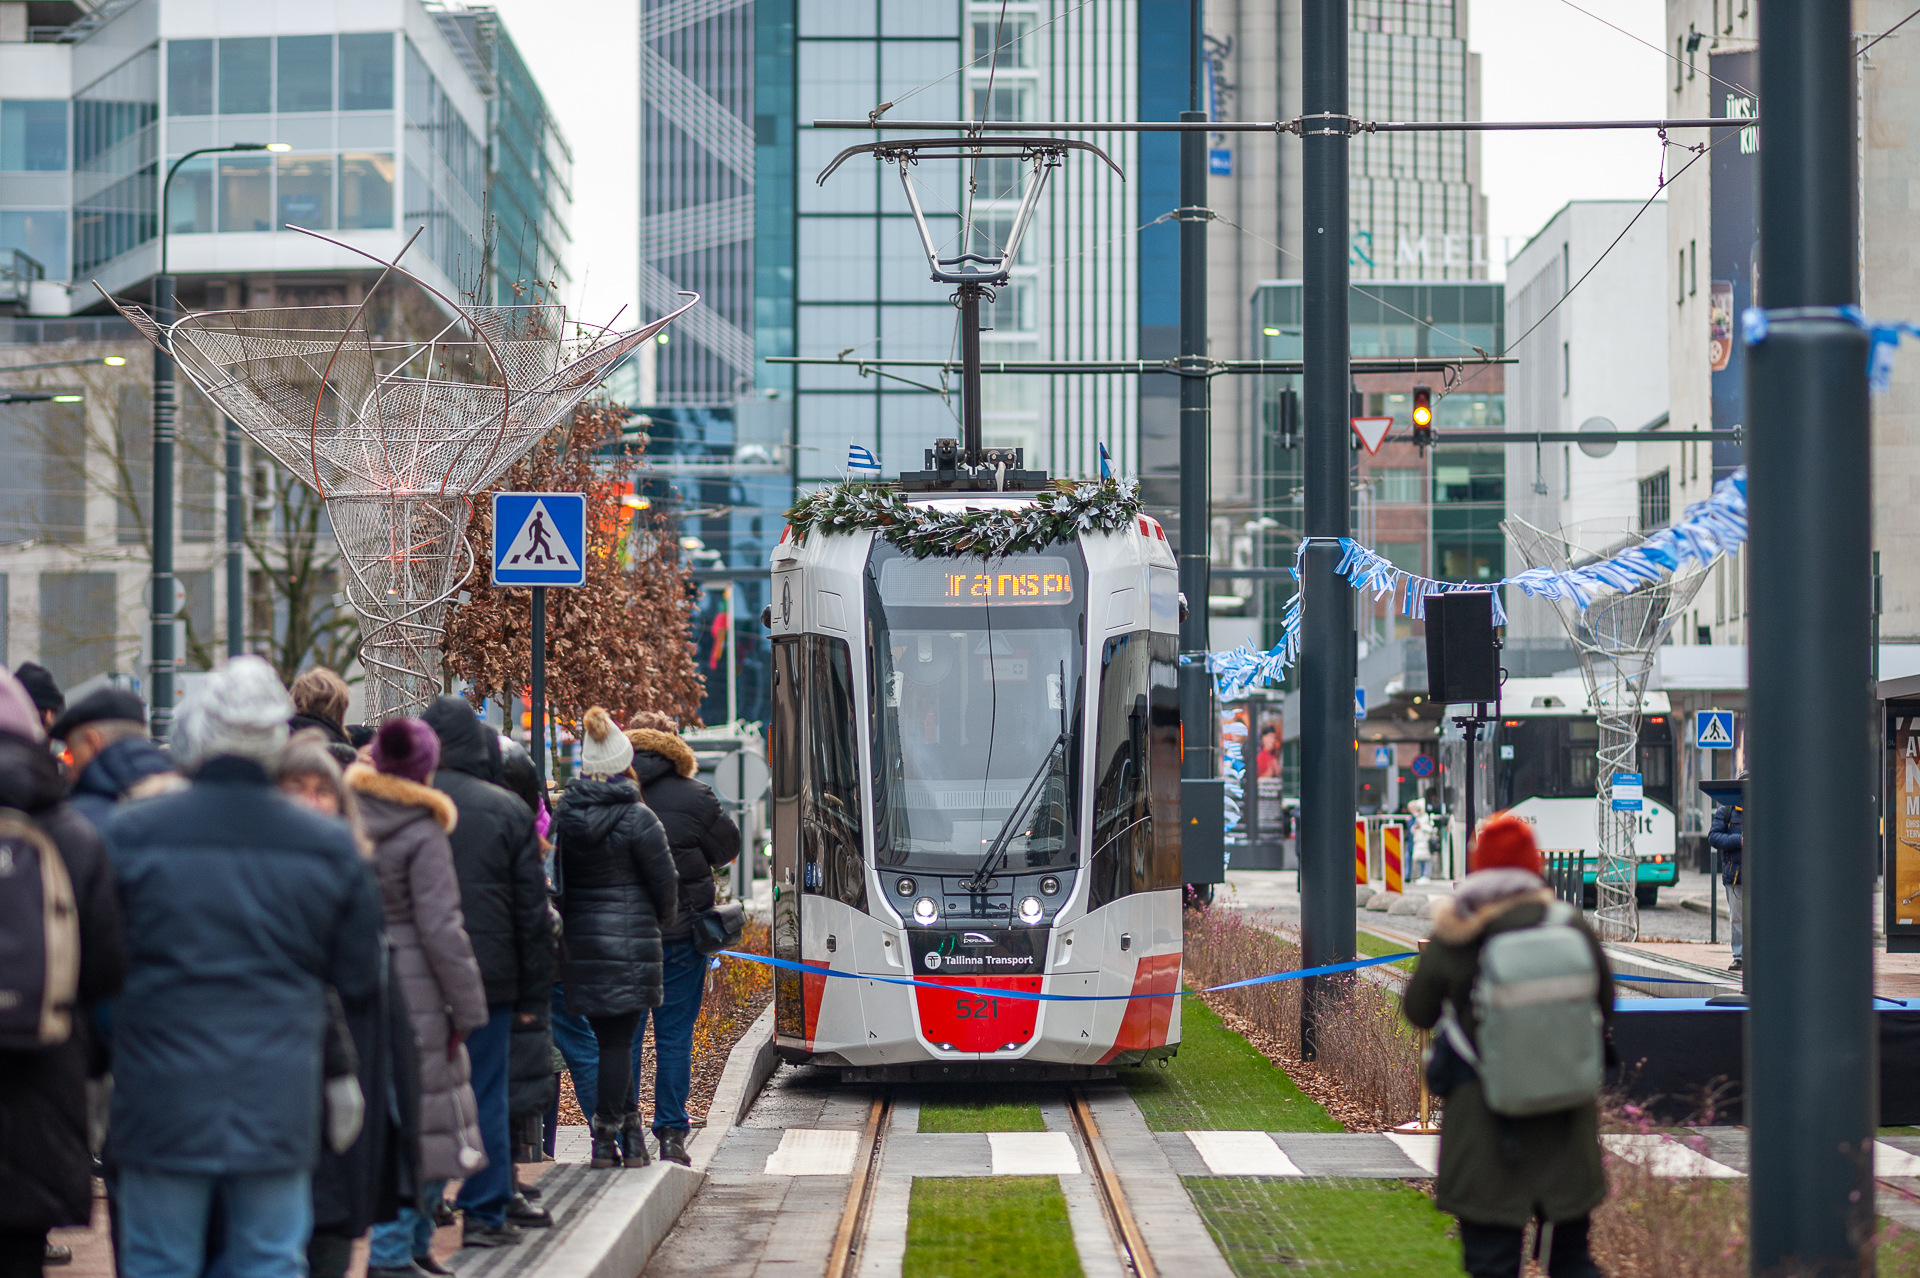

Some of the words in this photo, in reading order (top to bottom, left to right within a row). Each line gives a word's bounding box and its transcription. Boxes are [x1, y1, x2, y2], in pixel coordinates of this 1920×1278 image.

[944, 956, 984, 966] Tallinna
[985, 956, 1034, 967] Transport
[956, 998, 998, 1019] 521
